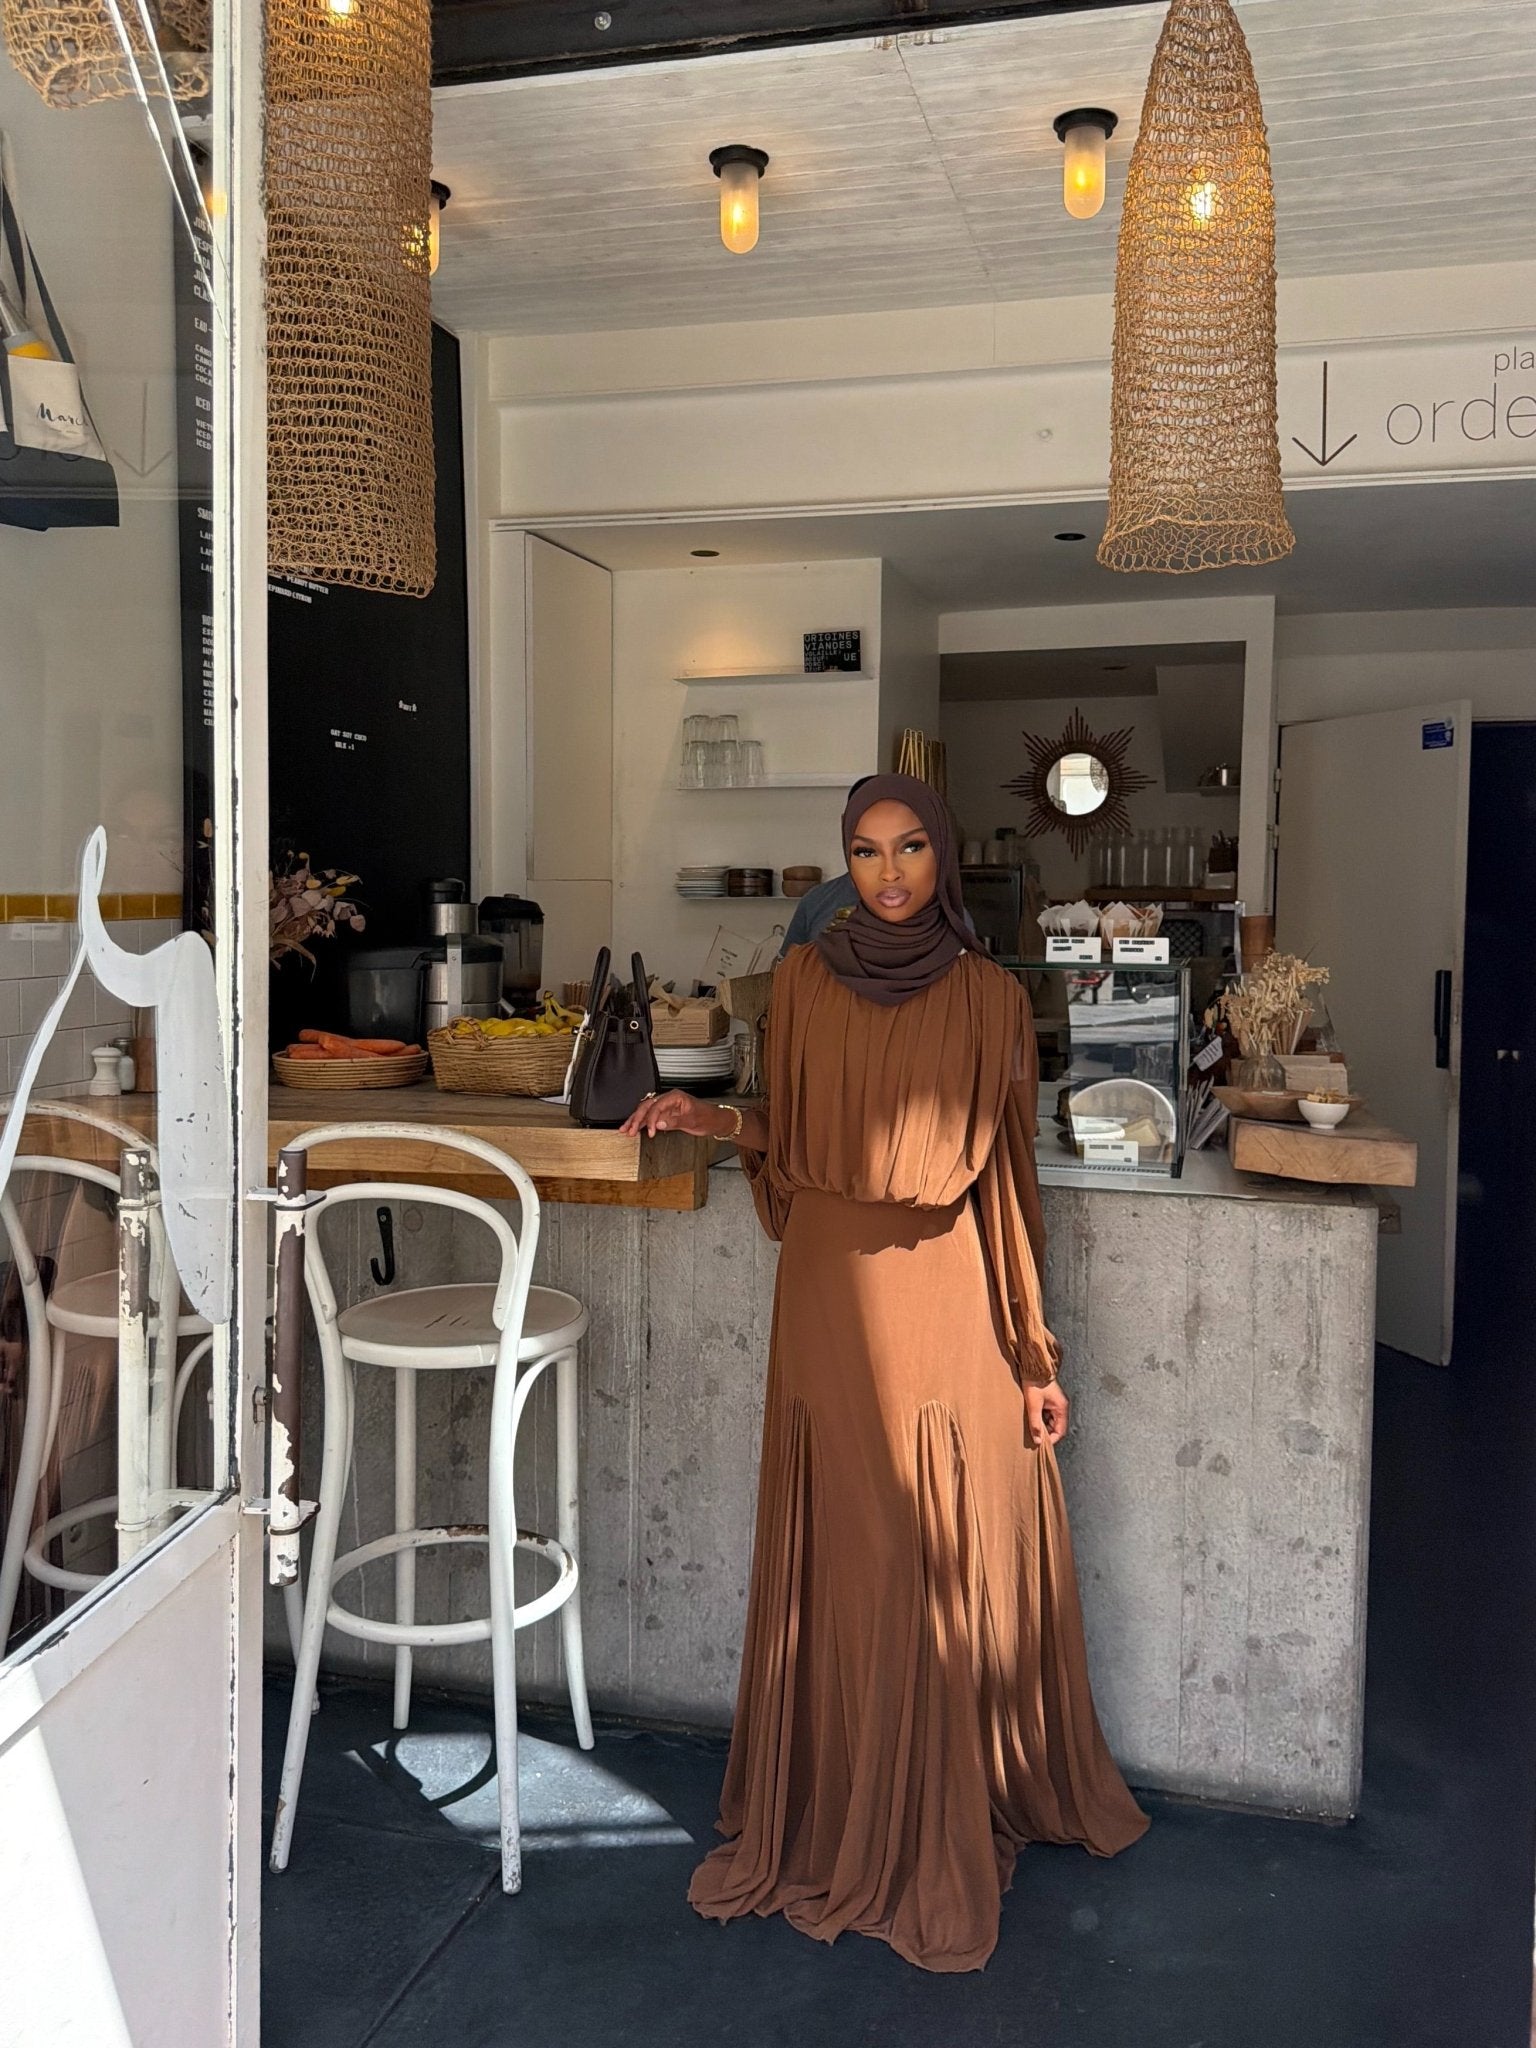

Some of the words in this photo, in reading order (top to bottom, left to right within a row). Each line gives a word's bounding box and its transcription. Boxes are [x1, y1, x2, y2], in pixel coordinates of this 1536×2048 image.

[1494, 345, 1535, 378] pla
[195, 363, 213, 377] COCA
[195, 373, 213, 388] COCA
[195, 395, 211, 412] ICED
[1386, 382, 1536, 446] orde
[804, 631, 859, 642] ORIGINES
[804, 640, 852, 651] VIANDES
[843, 652, 857, 661] UE
